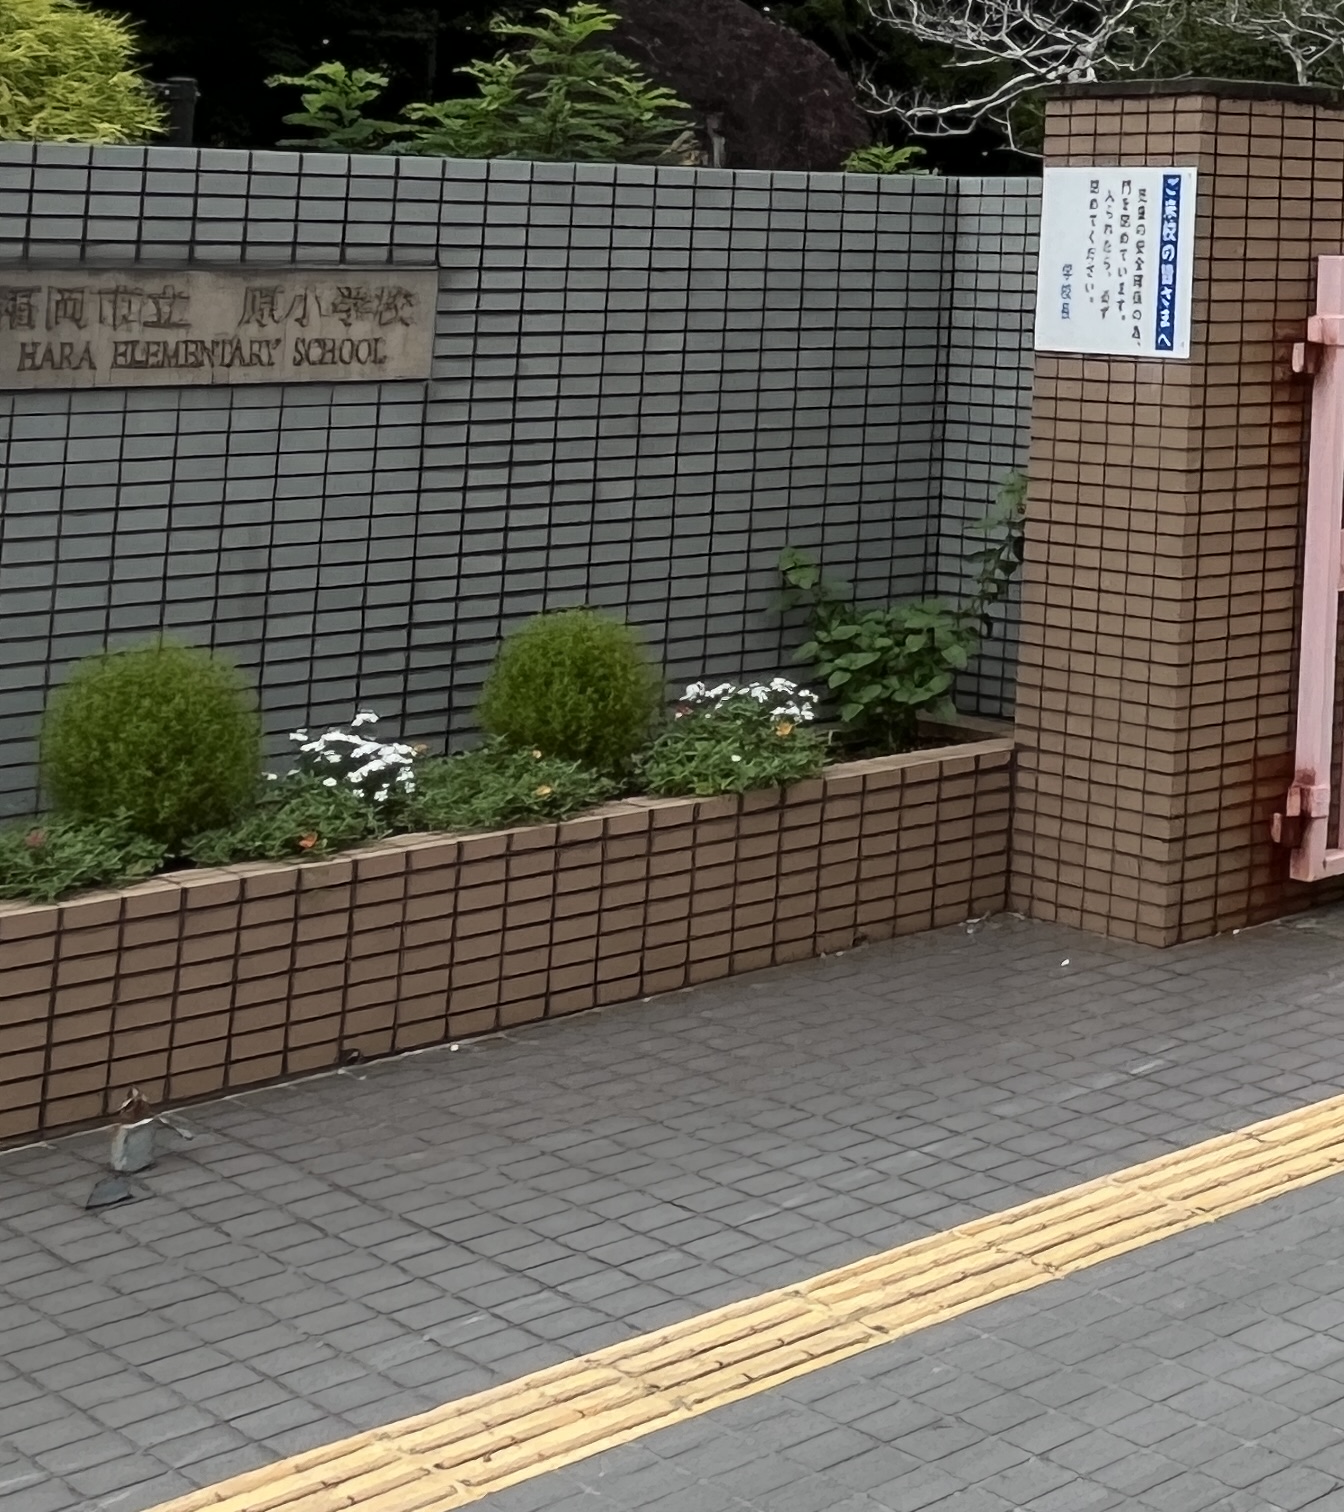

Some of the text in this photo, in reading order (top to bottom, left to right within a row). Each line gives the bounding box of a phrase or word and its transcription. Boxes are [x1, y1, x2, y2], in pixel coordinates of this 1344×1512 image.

[17, 337, 388, 372] HARA ELEMENTARY SCHOOL
